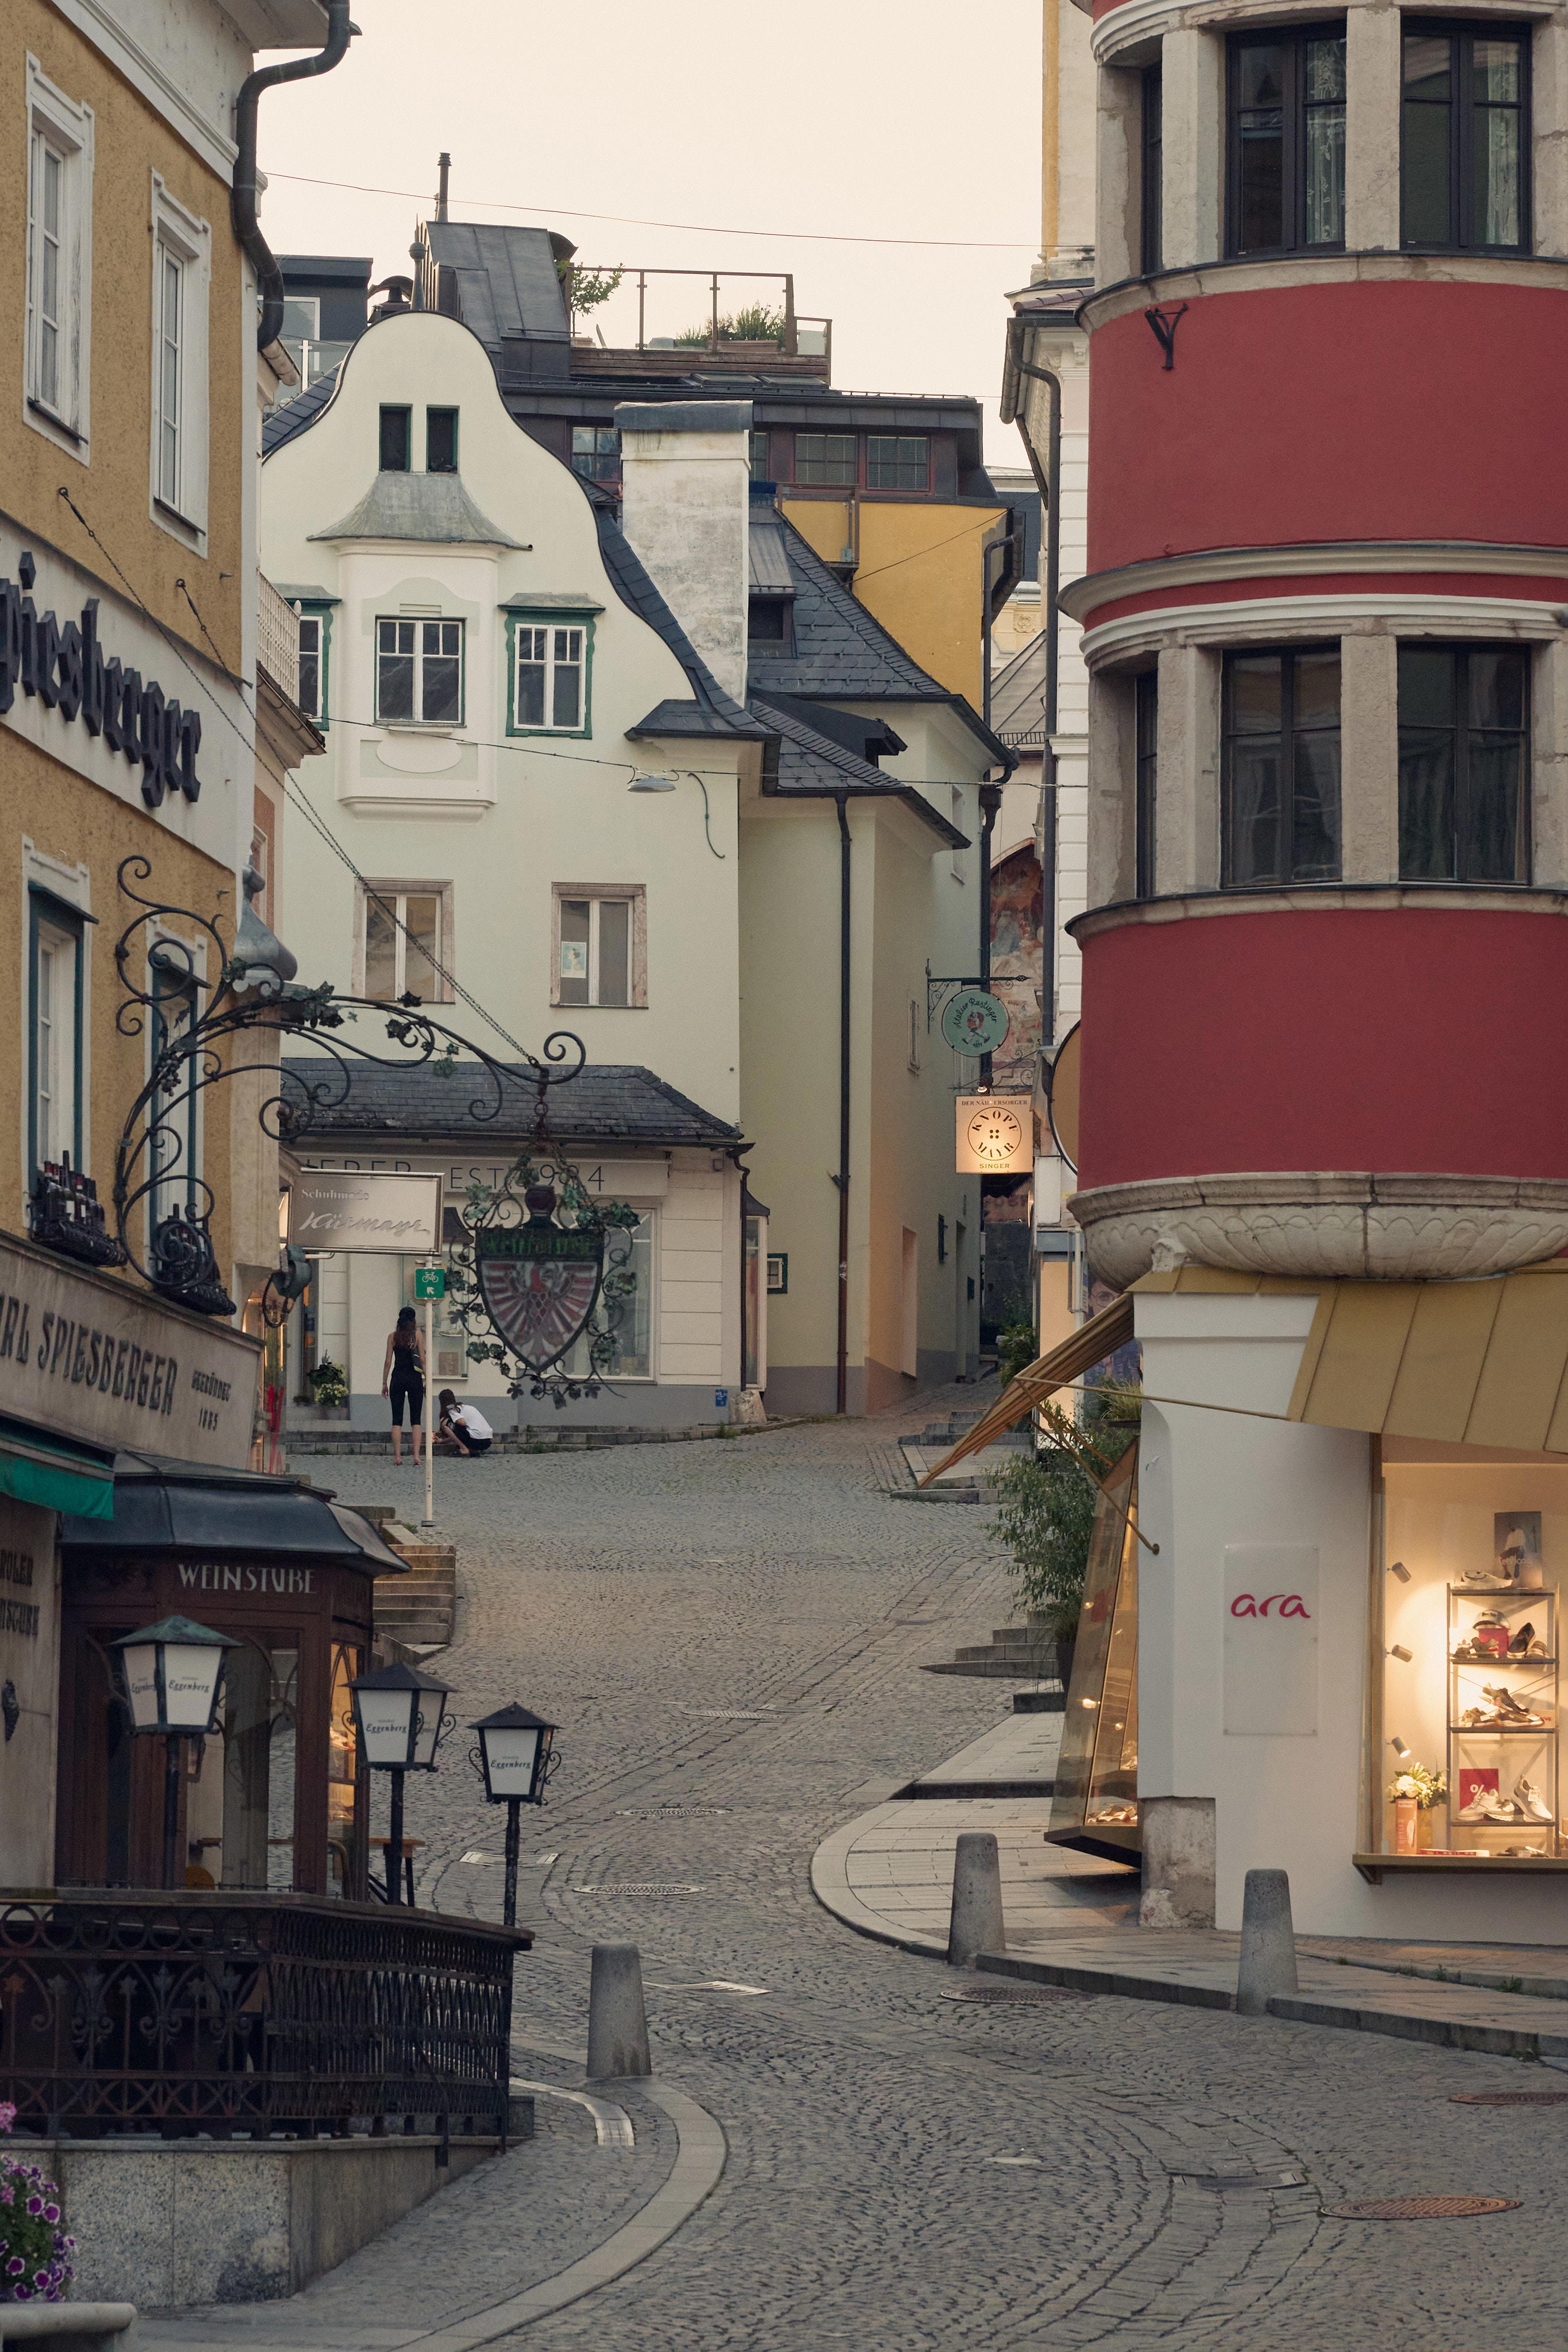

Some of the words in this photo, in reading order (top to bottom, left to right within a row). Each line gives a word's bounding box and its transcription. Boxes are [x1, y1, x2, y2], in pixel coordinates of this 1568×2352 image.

[971, 1110, 1019, 1132] KNOPF
[976, 1142, 1015, 1158] MAYR
[38, 1310, 177, 1416] SPIESBERGER
[177, 1564, 316, 1593] WEINSTUBE
[1231, 1594, 1311, 1618] ara
[168, 1680, 210, 1693] Eggenberg
[366, 1723, 406, 1734] Eggenberg
[490, 1759, 531, 1769] Eggenberg
